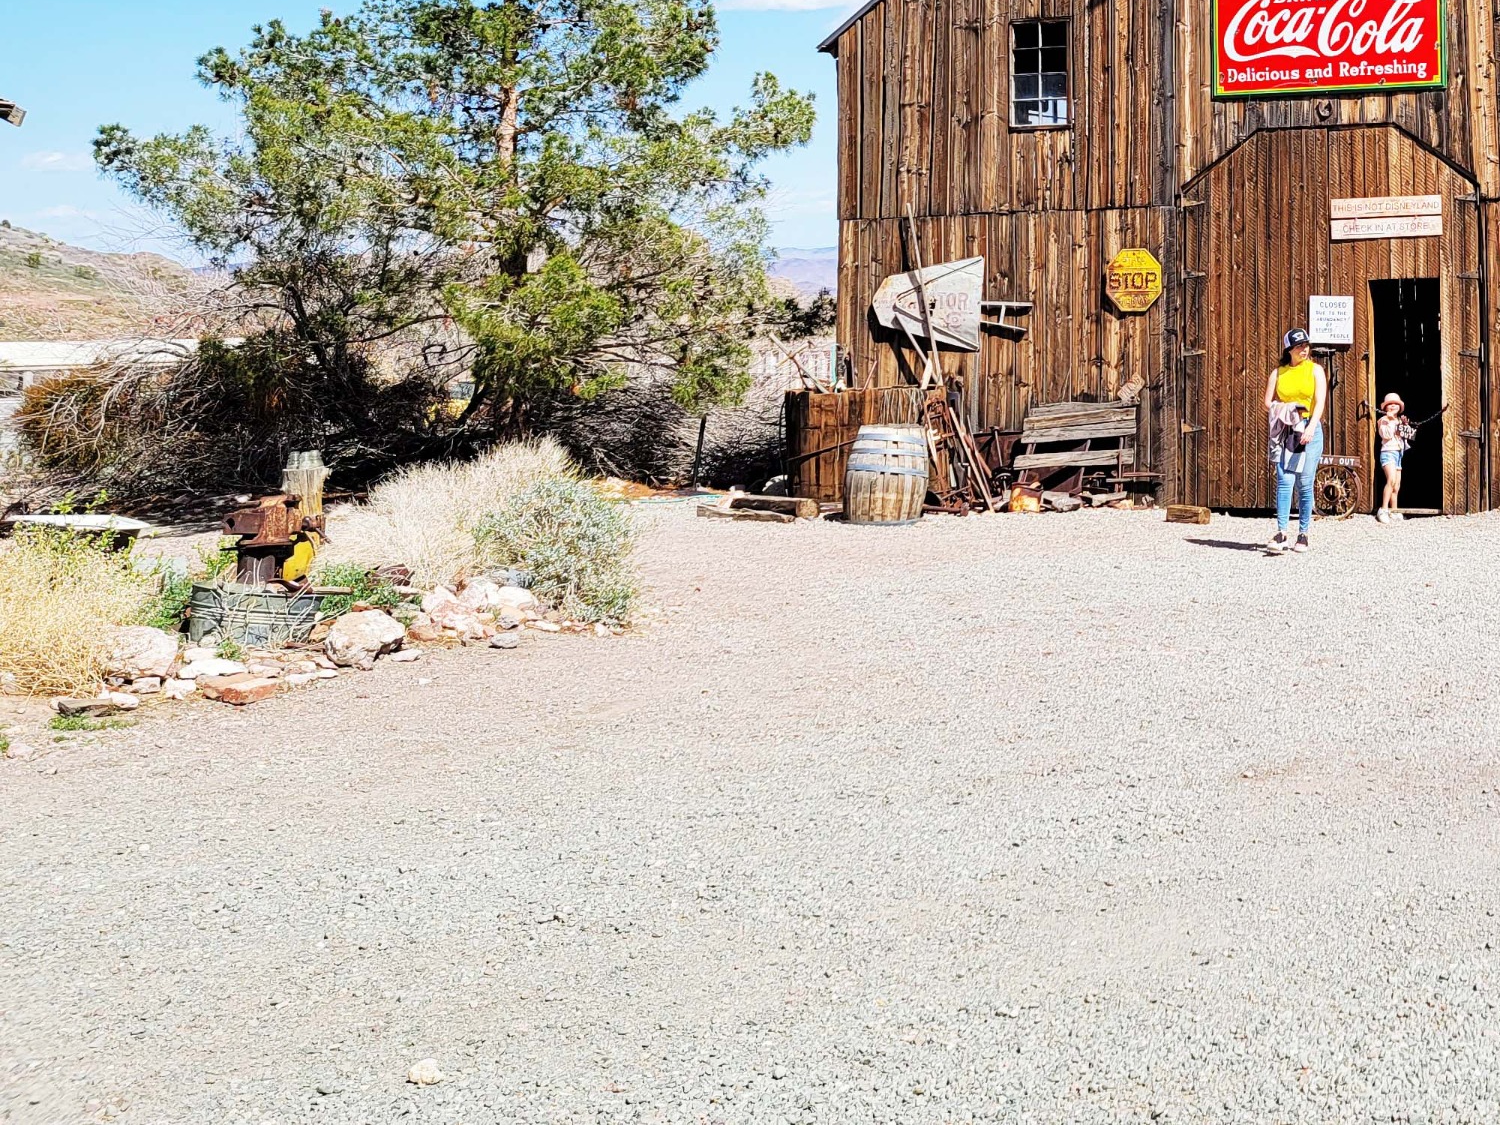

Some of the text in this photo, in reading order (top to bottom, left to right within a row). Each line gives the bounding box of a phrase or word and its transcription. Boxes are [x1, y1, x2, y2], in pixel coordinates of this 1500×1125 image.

[1227, 58, 1428, 84] Delicious and Refreshing
[1332, 201, 1440, 212] THIS IS NOT DISNEYLAND
[1342, 221, 1429, 234] CHECK IN AT STORE
[1109, 271, 1157, 289] STOP
[1319, 301, 1347, 309] CLOSED
[1398, 424, 1417, 435] STAY
[1399, 431, 1413, 440] OUT
[1319, 456, 1355, 466] TAY OUT
